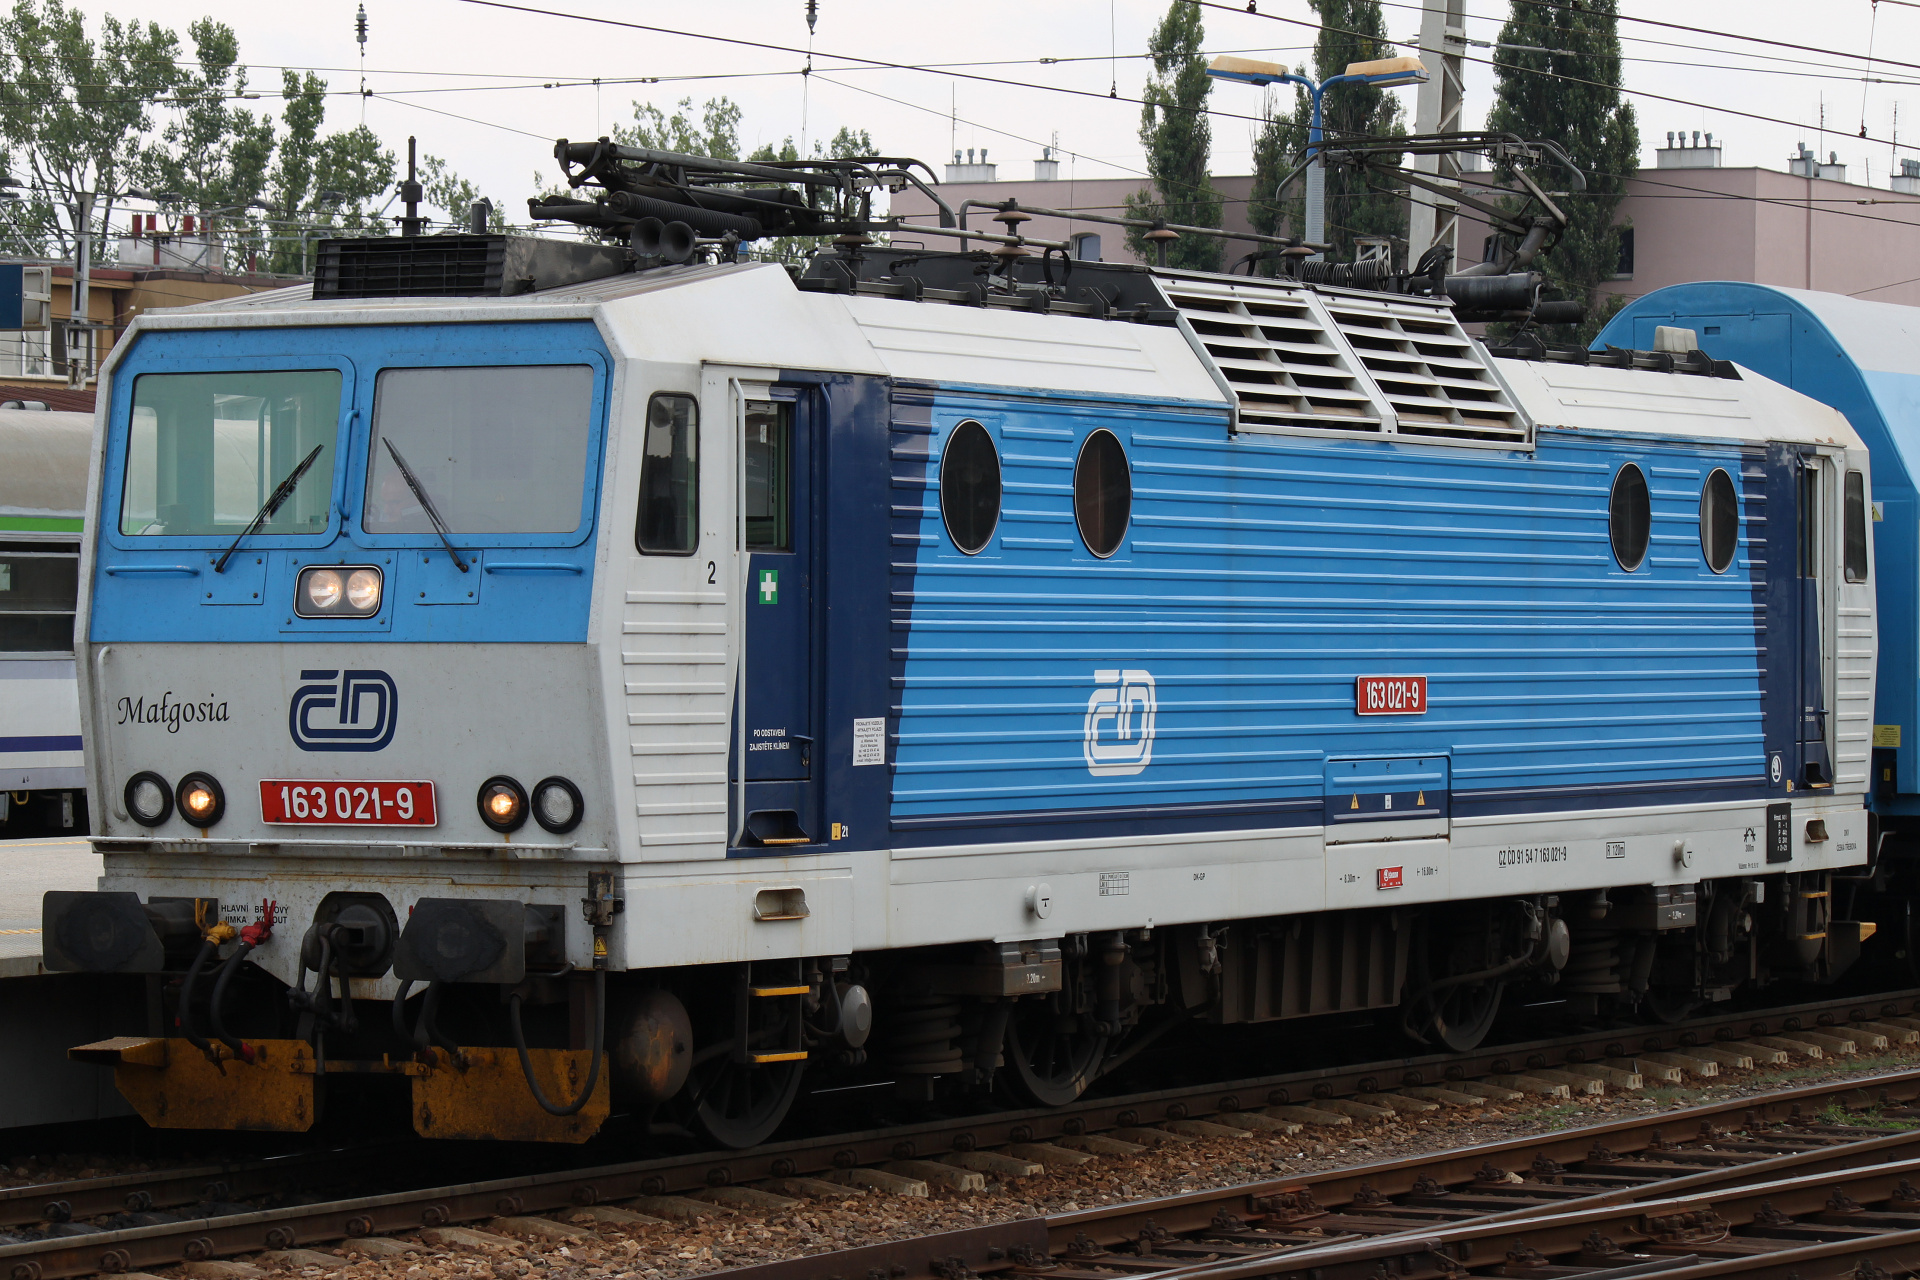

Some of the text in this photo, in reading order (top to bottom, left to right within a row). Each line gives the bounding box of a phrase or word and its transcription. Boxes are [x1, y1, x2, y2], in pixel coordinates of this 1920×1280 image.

[707, 560, 716, 585] 2
[1366, 681, 1420, 709] 163 021-9
[117, 690, 231, 734] Małgosia
[753, 729, 761, 737] PO
[280, 785, 415, 820] 163 021-9
[1498, 846, 1567, 866] CZ ČD 91 54 7 163 021-9
[220, 902, 249, 913] HLAVNÍ
[254, 904, 289, 914] BROVÝ
[256, 915, 288, 924] KOOUT
